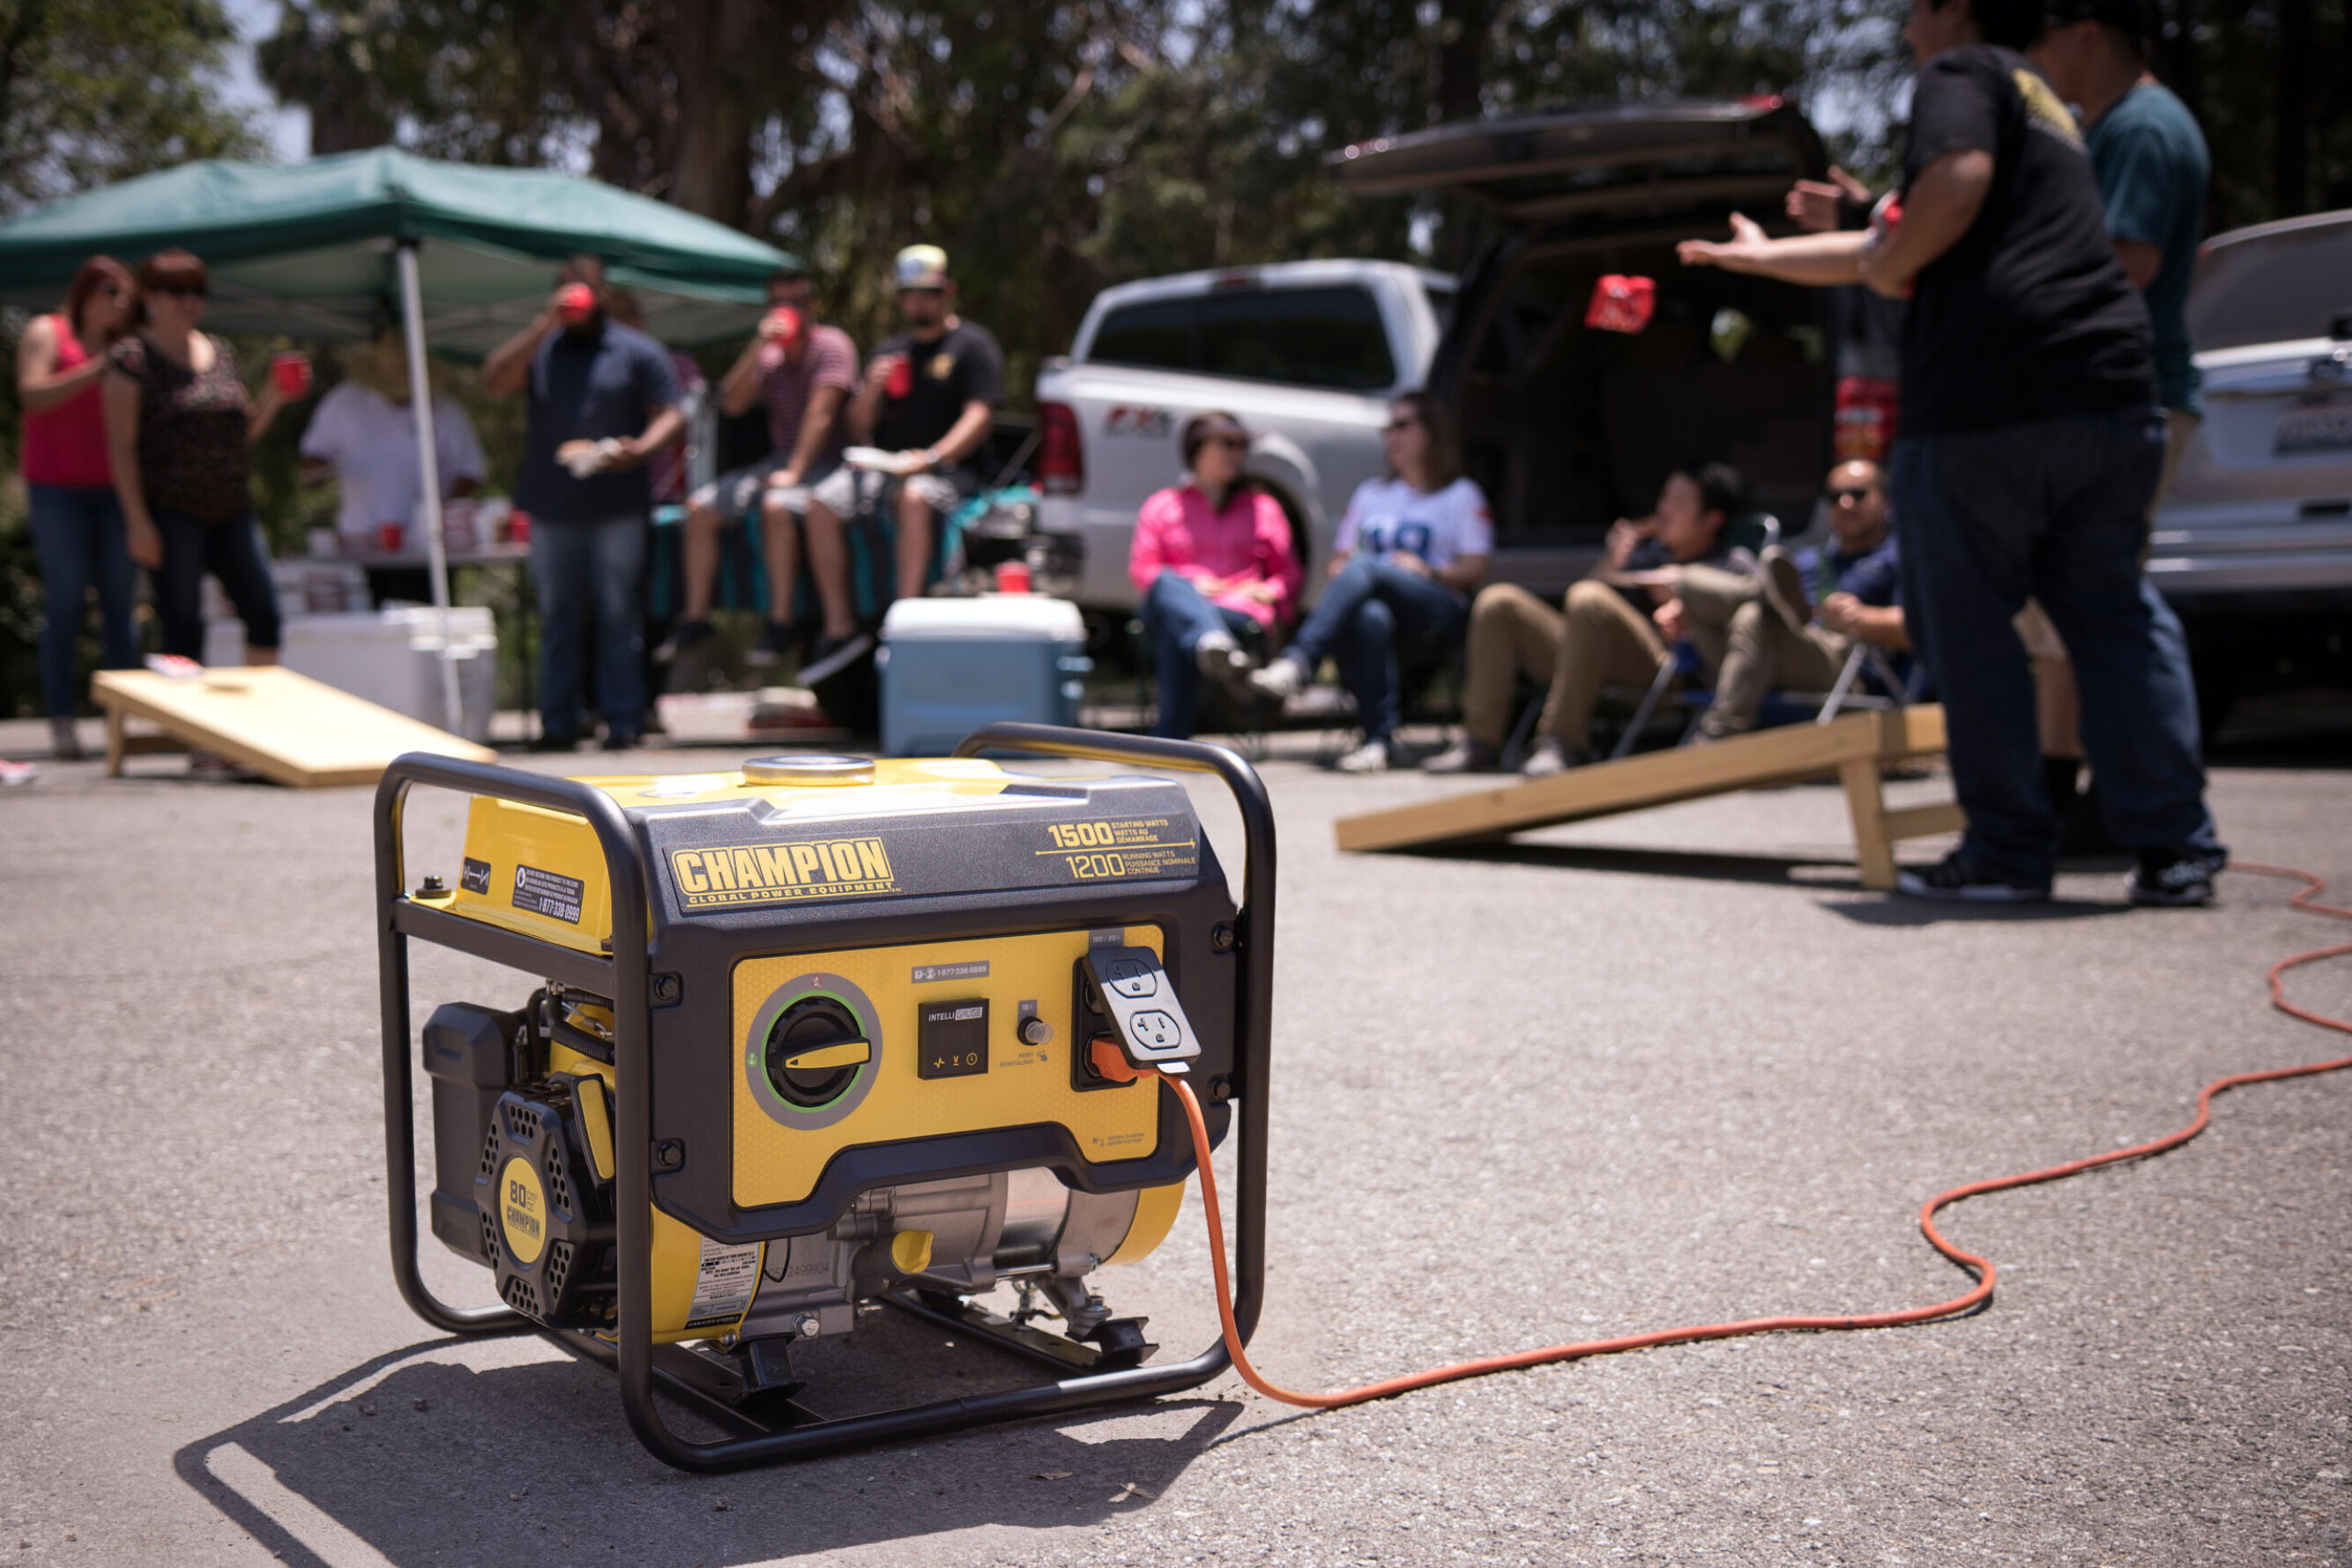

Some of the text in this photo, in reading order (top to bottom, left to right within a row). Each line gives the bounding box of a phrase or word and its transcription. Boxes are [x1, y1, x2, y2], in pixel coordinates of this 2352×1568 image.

[1047, 821, 1115, 848] 1500
[1111, 819, 1169, 829] STARTING WATTS
[1113, 829, 1137, 837] WATTS
[675, 840, 889, 894] CHAMPION
[1066, 853, 1126, 879] 1200
[1152, 851, 1176, 859] WATTS
[689, 893, 748, 904] GLOBAL
[751, 888, 803, 899] POWER
[811, 881, 893, 895] EQUIPMENT
[539, 896, 580, 922] 1-877-338-0999
[510, 1179, 526, 1208] 80
[507, 1204, 540, 1236] CHAMPION
